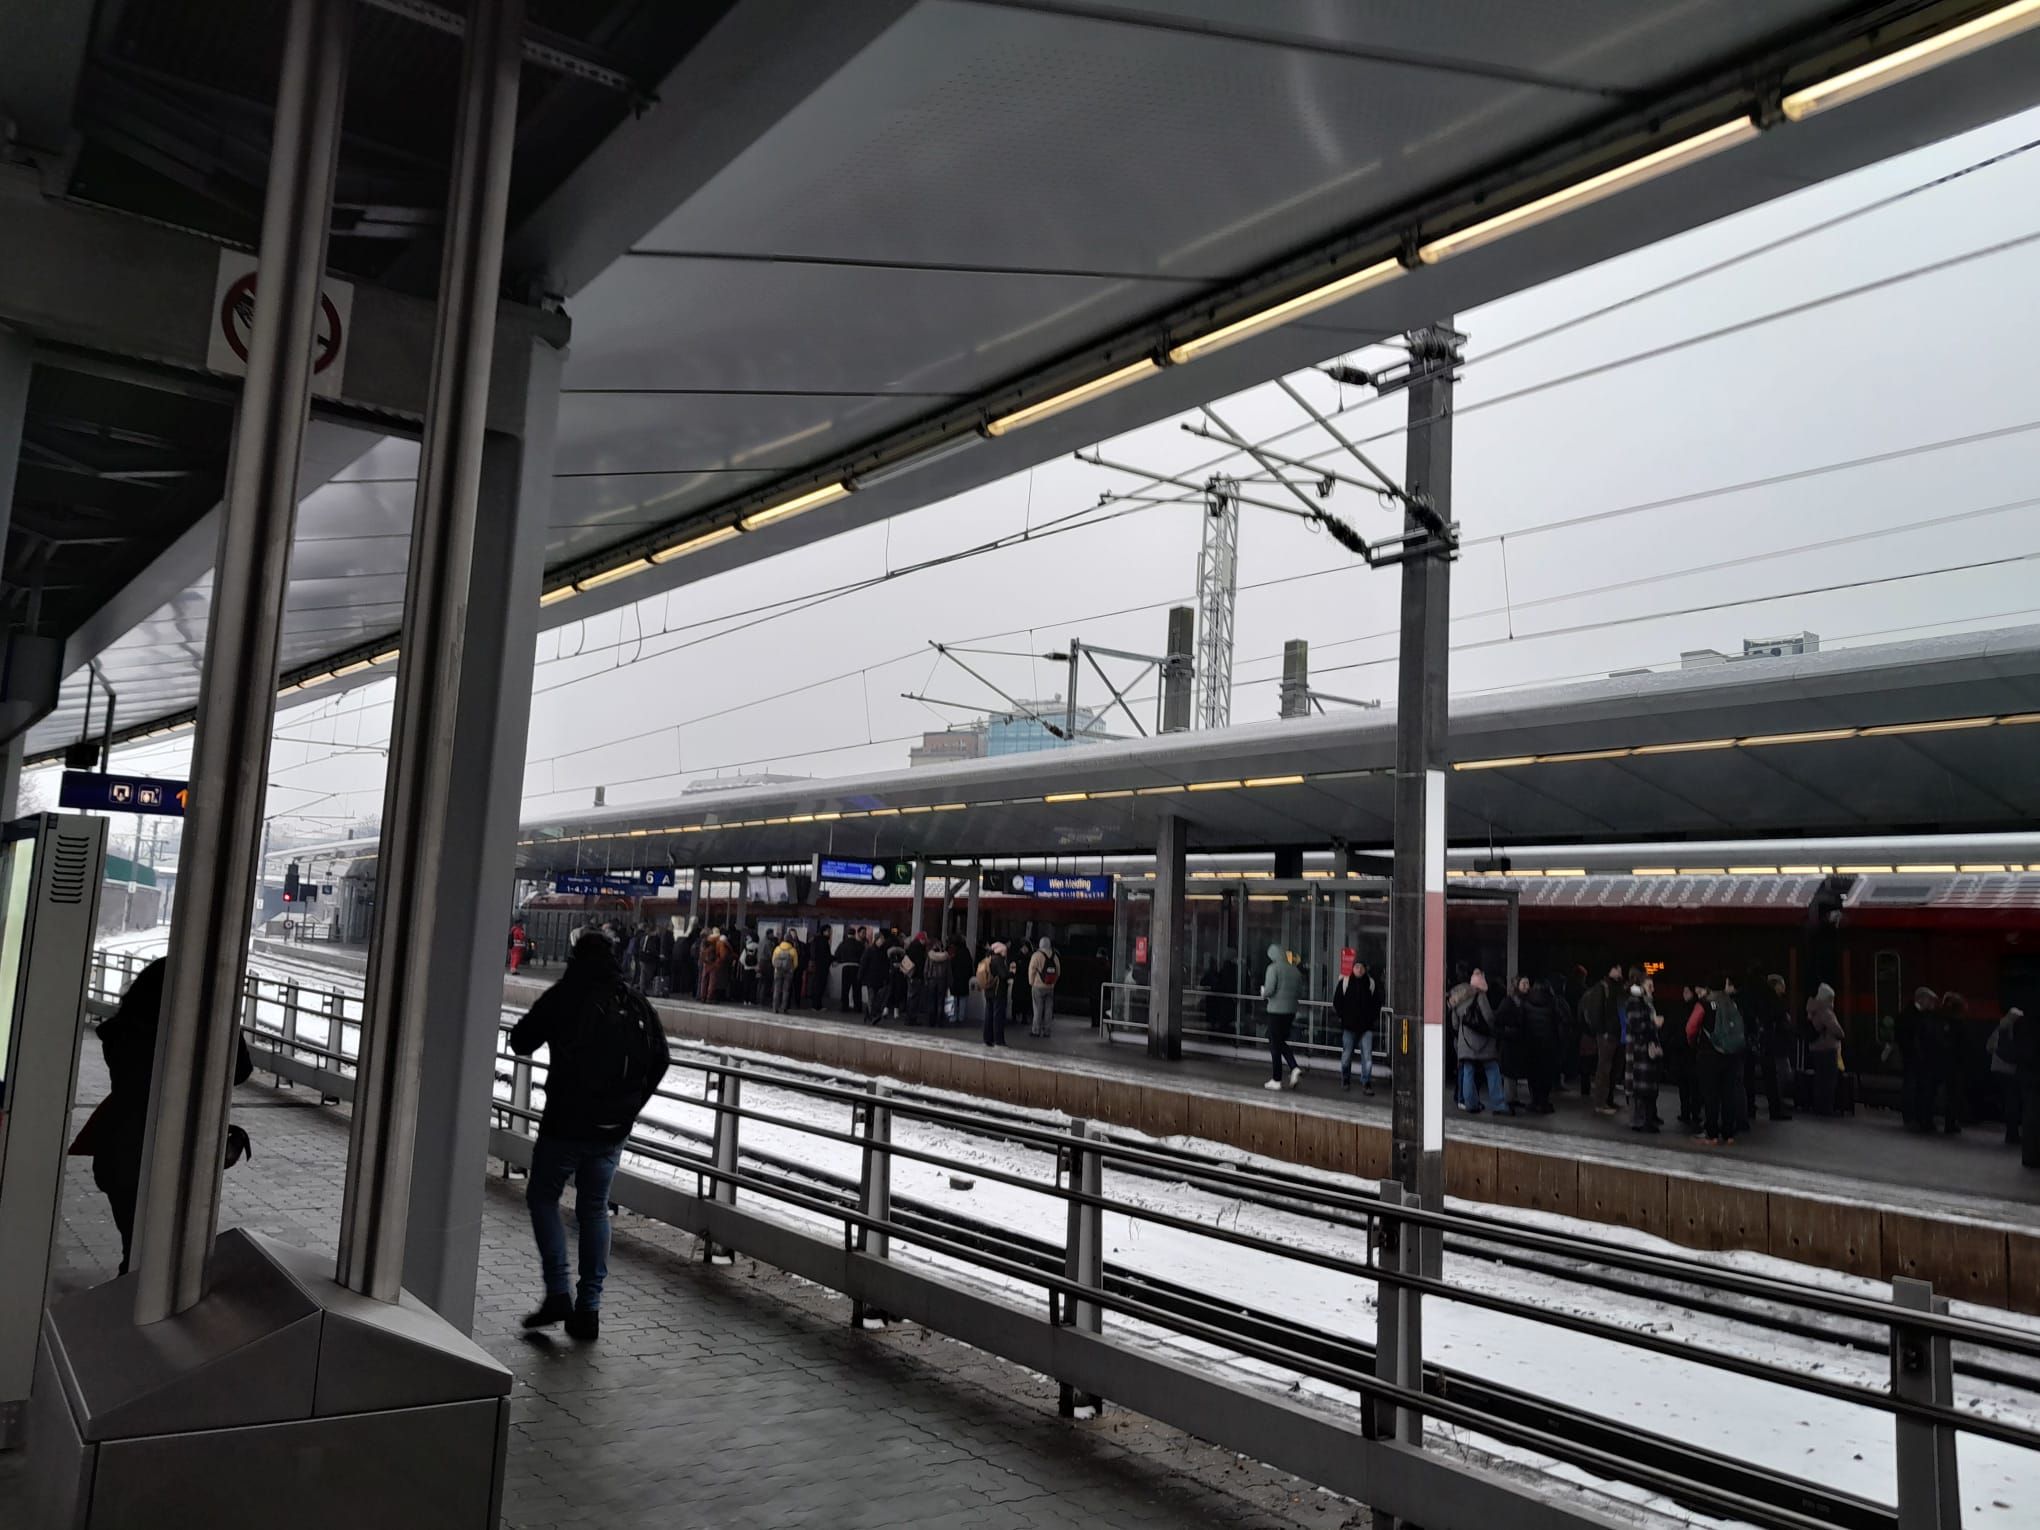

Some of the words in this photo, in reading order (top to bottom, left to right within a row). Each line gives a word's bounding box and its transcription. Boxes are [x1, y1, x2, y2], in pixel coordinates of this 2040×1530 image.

[645, 871, 655, 884] 6
[662, 875, 671, 885] A
[1049, 878, 1064, 889] Wien
[1065, 878, 1091, 891] Meidling
